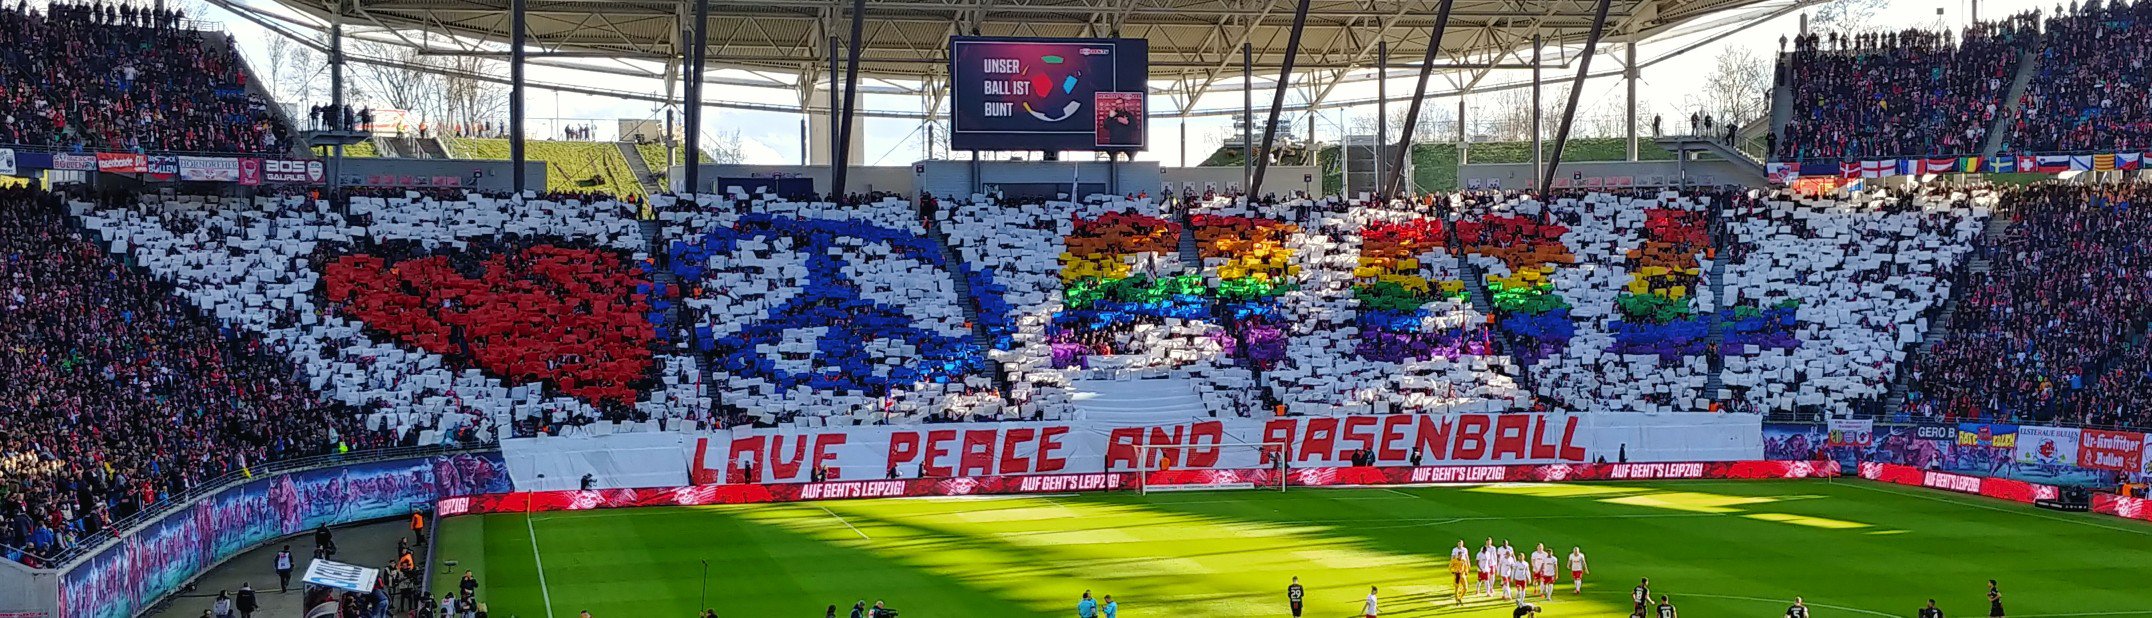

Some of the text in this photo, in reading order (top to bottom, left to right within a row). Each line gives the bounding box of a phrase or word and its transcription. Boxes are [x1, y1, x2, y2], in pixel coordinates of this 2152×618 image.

[984, 59, 1020, 74] UNSER
[984, 81, 1030, 95] BALL IST
[984, 102, 1014, 117] BUNT
[1918, 427, 1946, 438] GERO
[692, 413, 1586, 485] LOVE PEACE AND RASENBALL
[1411, 466, 1507, 482] AUF GEHT'S LEIPZIG!
[1611, 463, 1704, 478] AUF GEHT'S LEIPZIG!
[1020, 477, 1042, 491] AUF
[1042, 475, 1077, 490] GEHT'S
[1924, 471, 1937, 486] AUF
[800, 481, 906, 499] AUF GEHT'S LEIPZIG!
[1290, 589, 1301, 599] 29
[1662, 609, 1672, 618] 10
